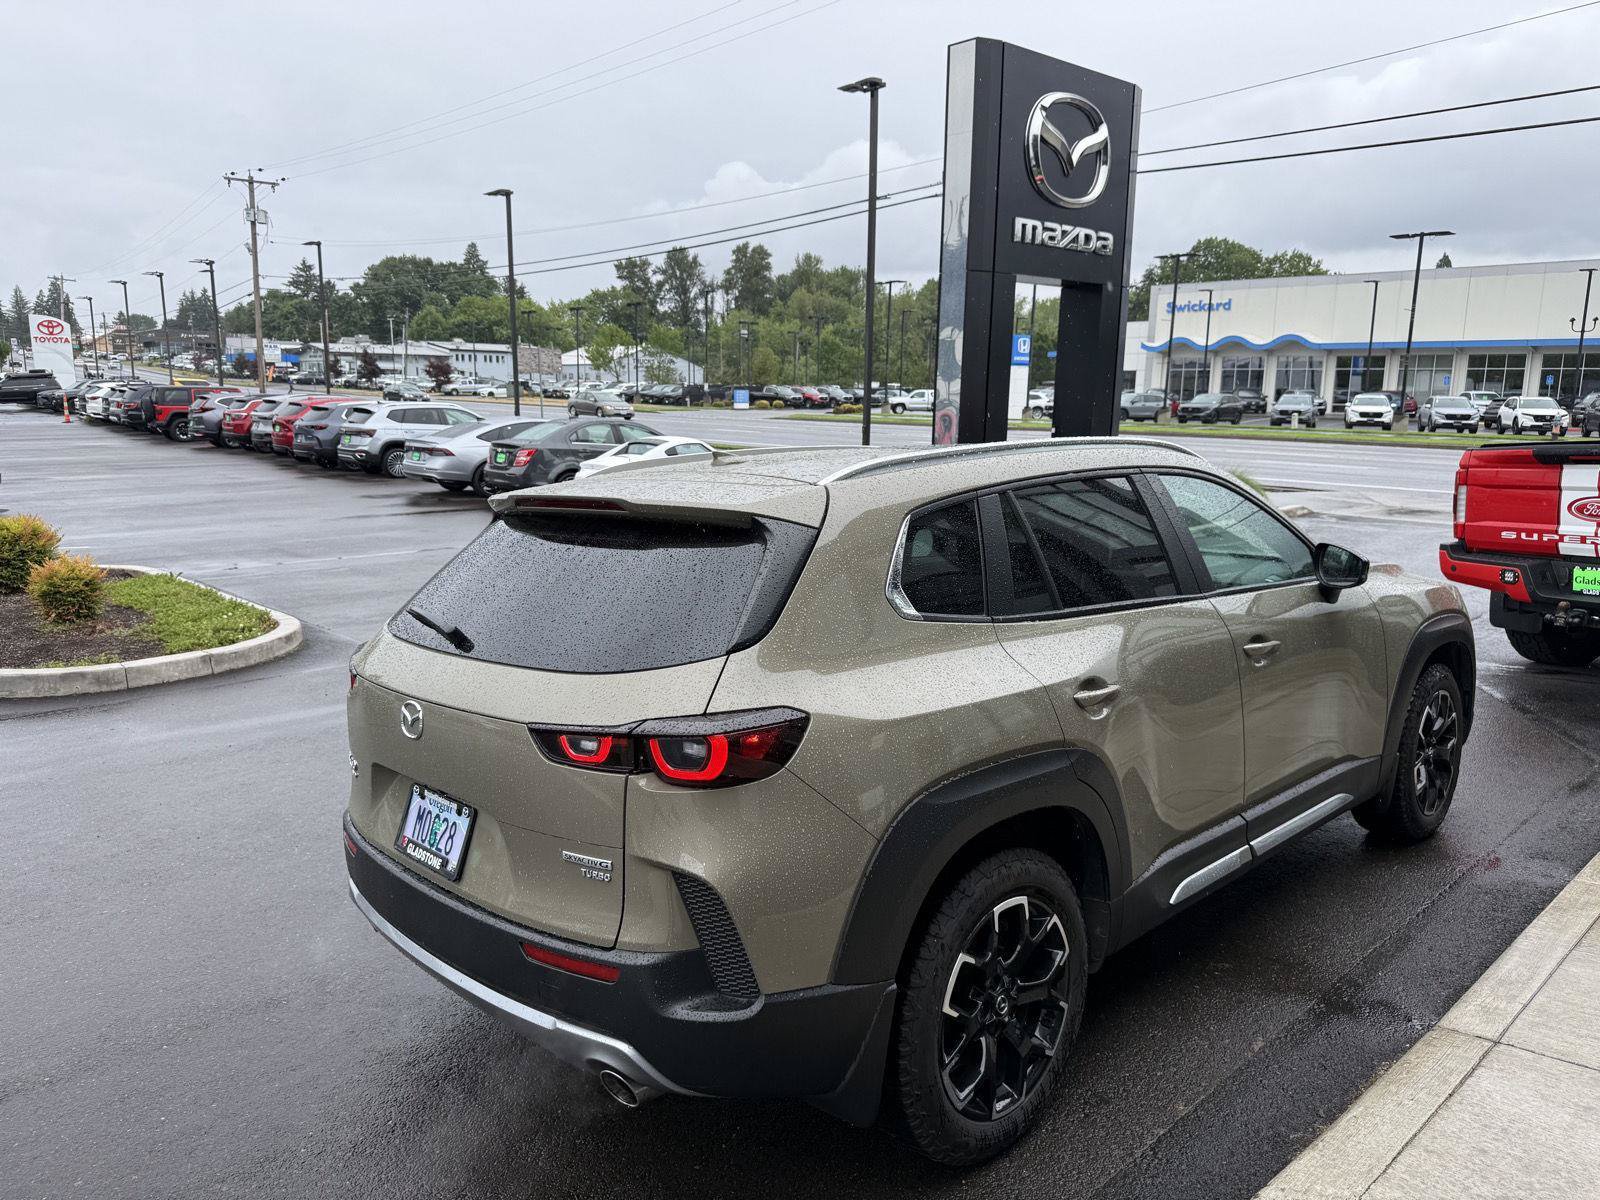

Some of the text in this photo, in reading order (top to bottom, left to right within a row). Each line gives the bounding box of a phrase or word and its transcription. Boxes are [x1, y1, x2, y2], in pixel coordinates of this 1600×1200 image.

[1166, 298, 1232, 315] Swickard
[406, 842, 443, 870] GLADSTONE
[581, 868, 611, 881] TURBO
